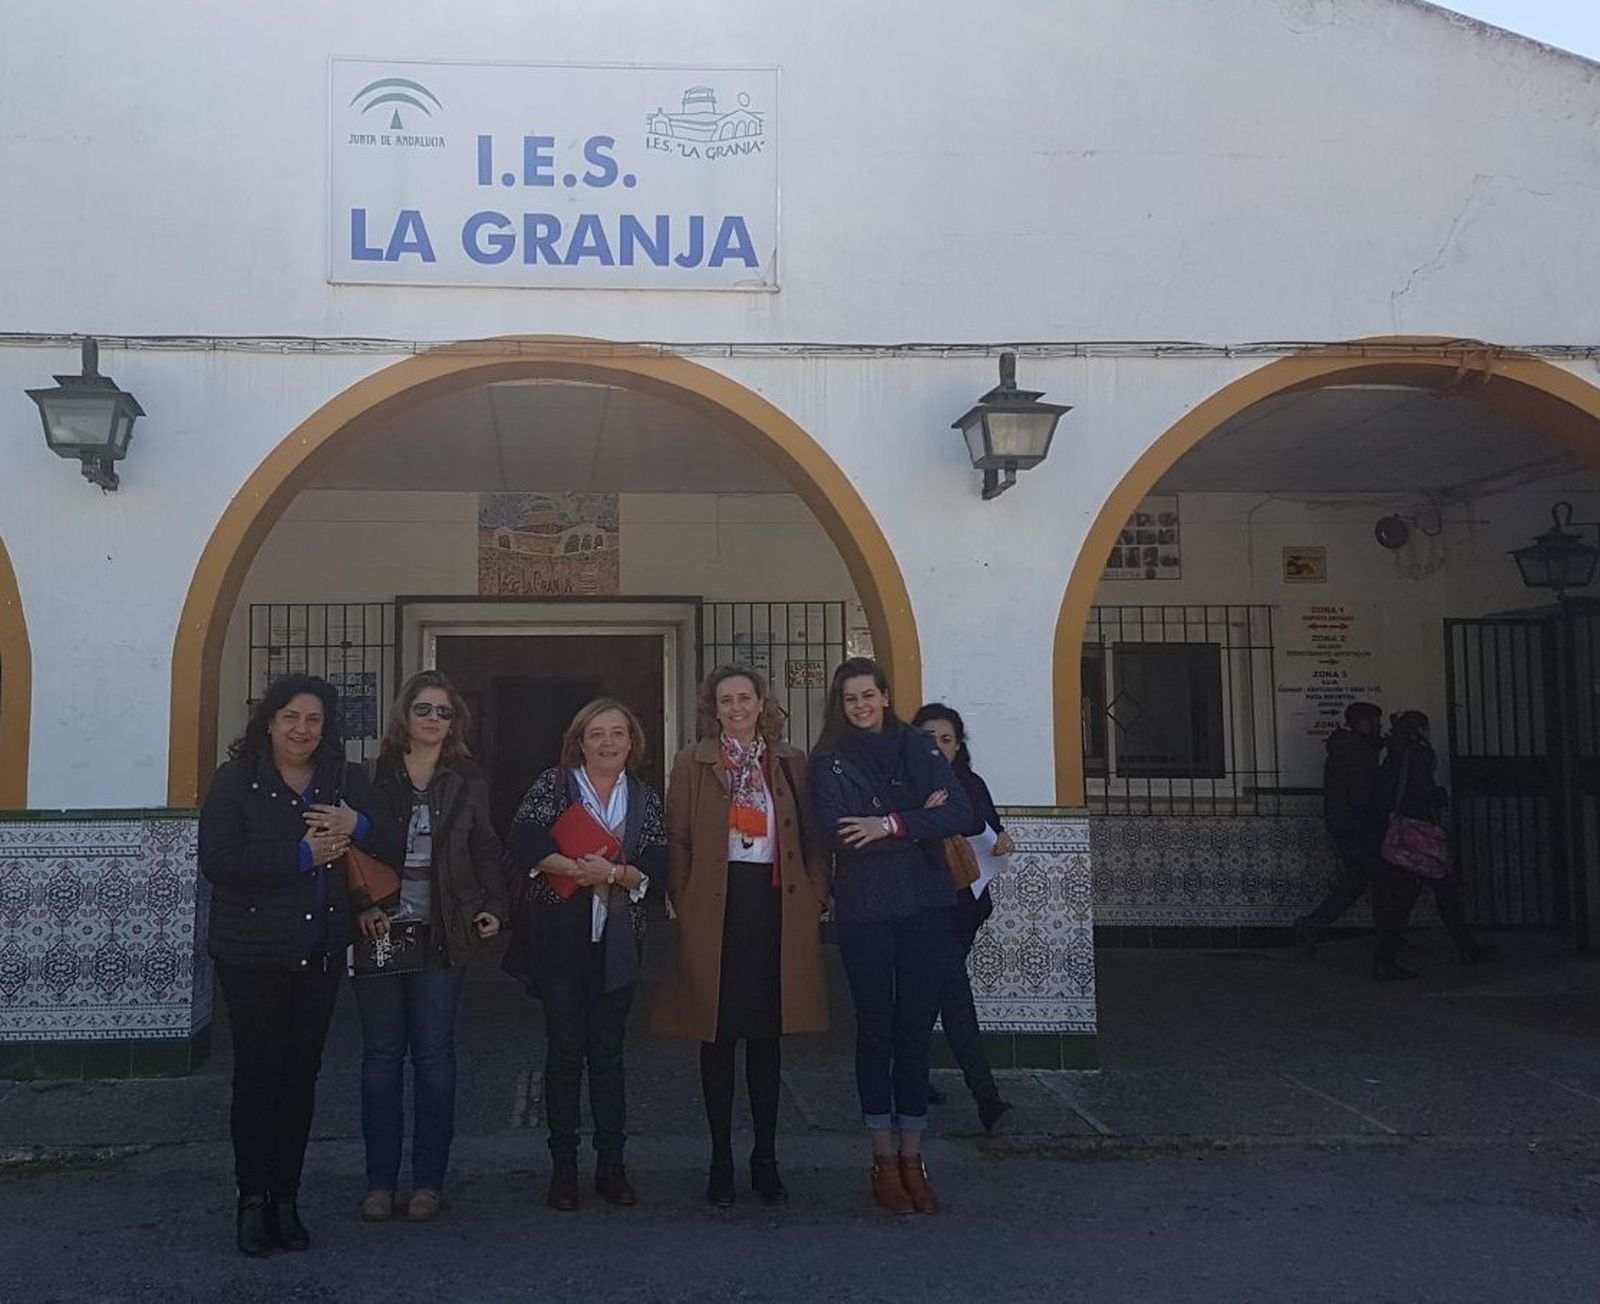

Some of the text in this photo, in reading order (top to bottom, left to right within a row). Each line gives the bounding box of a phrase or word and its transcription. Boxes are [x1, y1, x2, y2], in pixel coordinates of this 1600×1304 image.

[348, 133, 377, 145] JUNTA
[380, 135, 392, 146] DE
[478, 136, 637, 188] I.E.S.
[350, 208, 757, 269] LA GRANJA
[1312, 670, 1340, 678] ZONA
